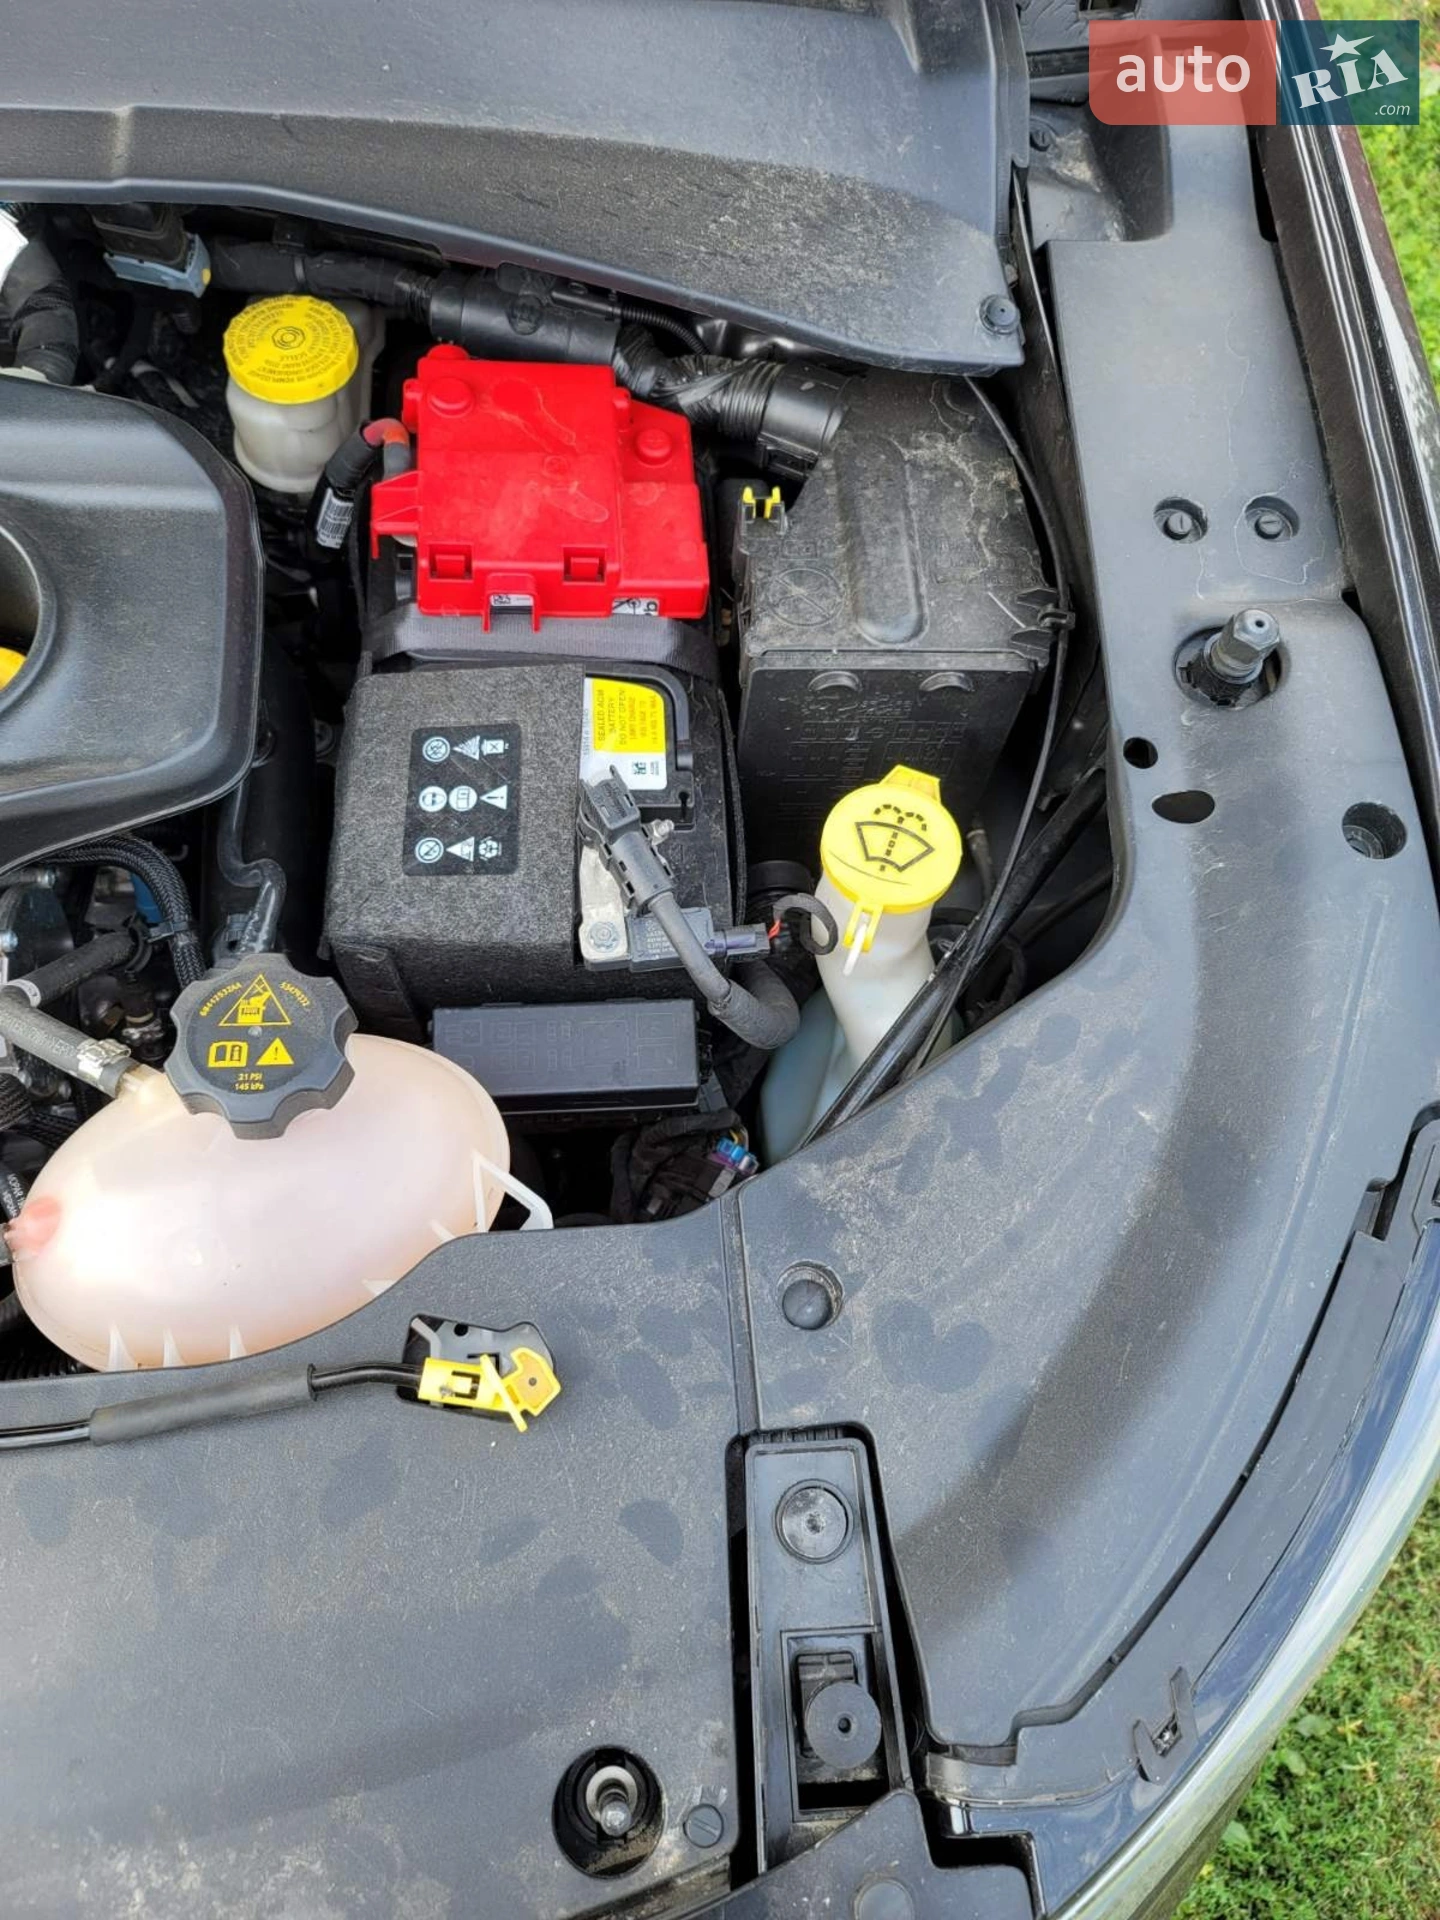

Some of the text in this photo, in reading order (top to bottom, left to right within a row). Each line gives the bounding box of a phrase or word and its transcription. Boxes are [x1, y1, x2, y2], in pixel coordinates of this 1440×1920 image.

[597, 710, 606, 742] SEALED
[238, 1073, 263, 1081] 21 PSI
